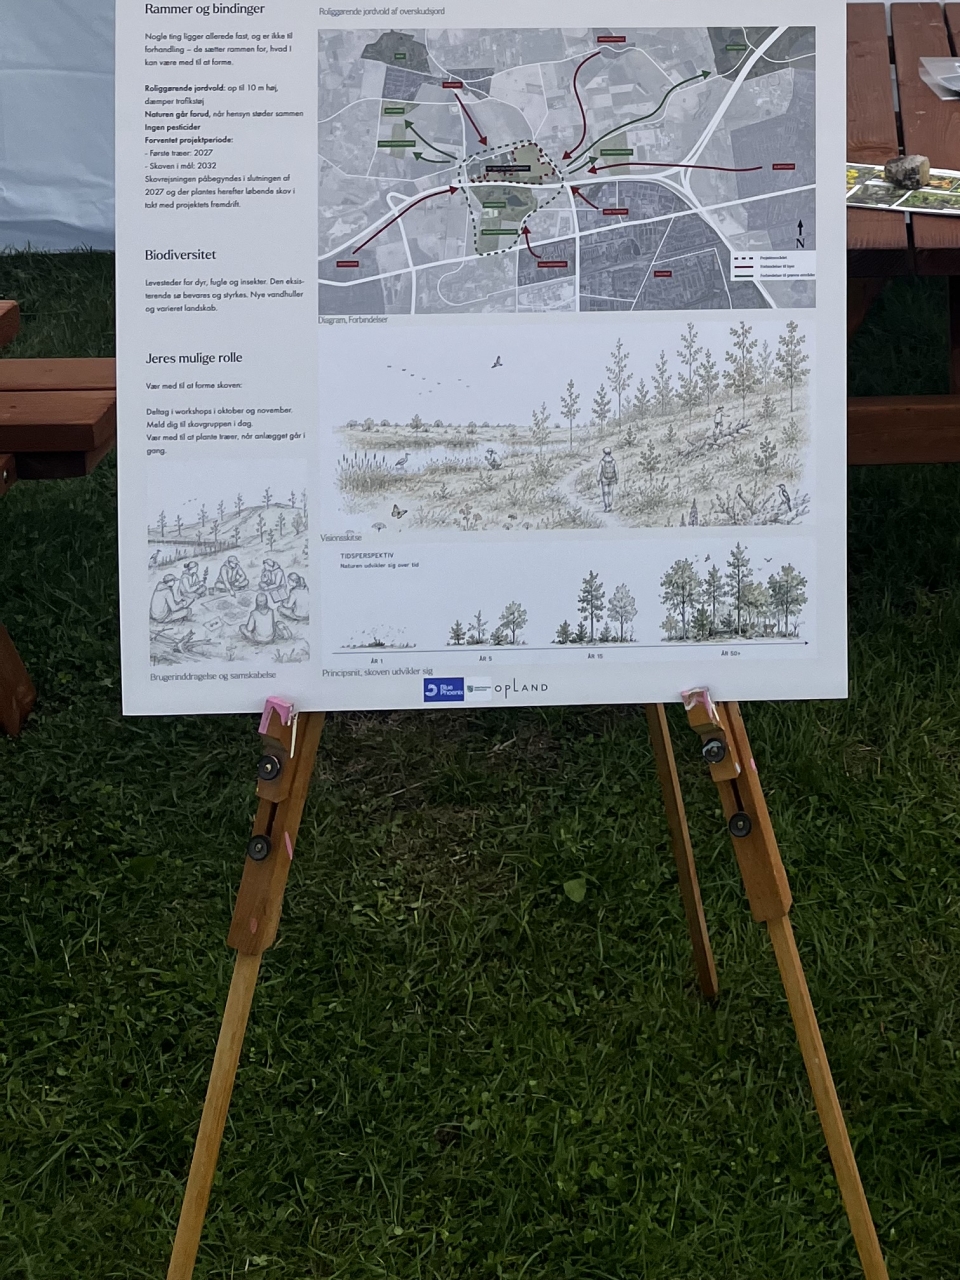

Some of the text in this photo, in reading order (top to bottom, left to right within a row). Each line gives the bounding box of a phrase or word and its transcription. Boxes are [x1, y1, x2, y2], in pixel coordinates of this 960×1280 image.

[144, 2, 266, 17] Rammer og bindinger
[318, 6, 446, 18] Roliggørende jordvold af overskudsjord
[144, 122, 201, 133] Ingen pesticider
[144, 134, 234, 146] Forventet projektperiode:
[796, 238, 806, 249] N
[144, 247, 217, 261] Biodiversitet
[144, 303, 218, 315] og varieret landskab.
[317, 314, 388, 326] Diagram, Forbindelser
[145, 351, 243, 366] Jeres mulige rolle
[145, 380, 243, 390] Vær med til at forme skoven:
[319, 531, 363, 543] Visionsskitse
[339, 551, 394, 560] TIDSPERSPEKTIV
[387, 562, 396, 570] sig
[478, 654, 487, 662] ÅR
[596, 652, 604, 660] 15
[720, 649, 741, 657] ÅR 50+
[370, 656, 379, 664] ÅR
[149, 669, 277, 683] Brugerinddragelse og samskabelse
[321, 666, 434, 679] Principsnit, skoven udvikler sig
